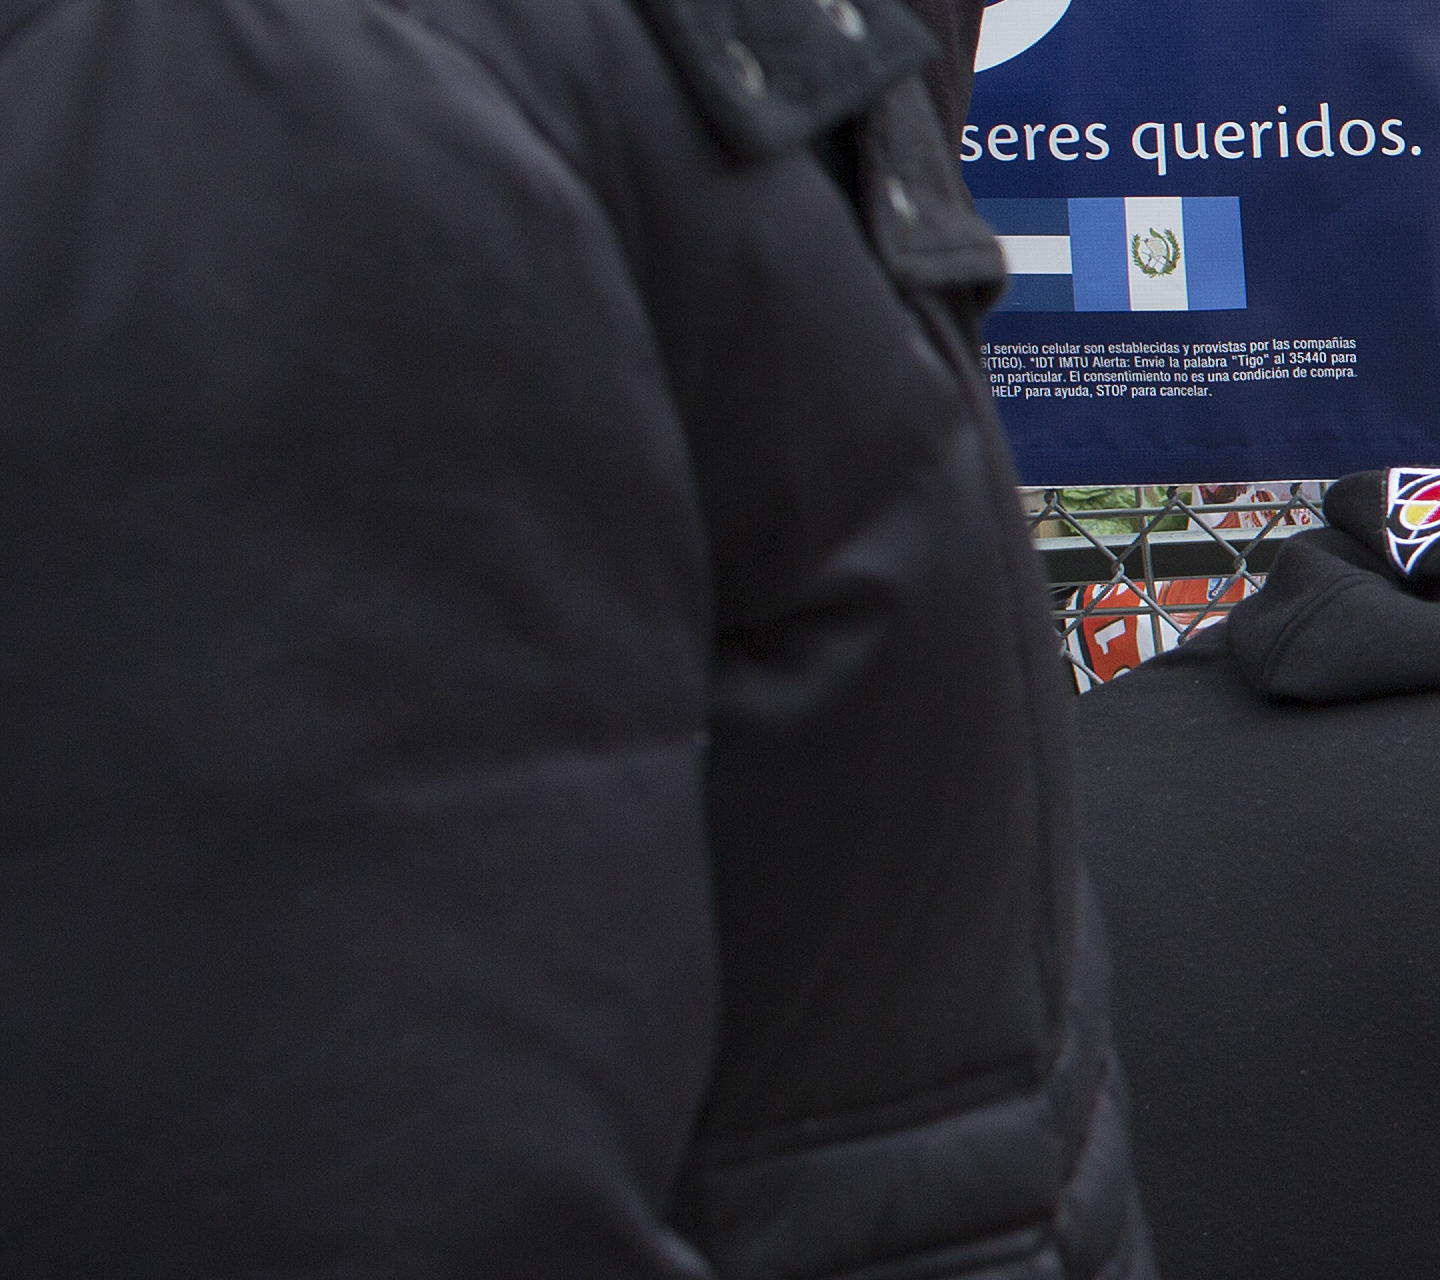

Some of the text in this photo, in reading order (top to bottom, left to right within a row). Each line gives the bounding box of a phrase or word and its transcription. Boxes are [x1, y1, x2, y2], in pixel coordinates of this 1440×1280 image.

[959, 102, 1421, 176] seres queridos.
[994, 342, 1039, 355] servicio
[1042, 342, 1081, 356] celular
[1084, 345, 1105, 356] son
[1108, 341, 1180, 356] establecidas
[1182, 345, 1189, 356] y
[1193, 340, 1247, 355] provistas
[1250, 340, 1269, 354] por
[1272, 338, 1290, 352] las
[1092, 355, 1130, 371] Alerta:
[1169, 356, 1180, 367] la
[1183, 353, 1227, 370] palabra
[1273, 352, 1284, 367] al
[1289, 350, 1326, 363] 35440
[1331, 353, 1357, 365] para
[989, 364, 1357, 385] en particular. El consentimiento no es una condición de compra.
[991, 382, 1212, 399] HELP para ayuda, STOP para cancelar.
